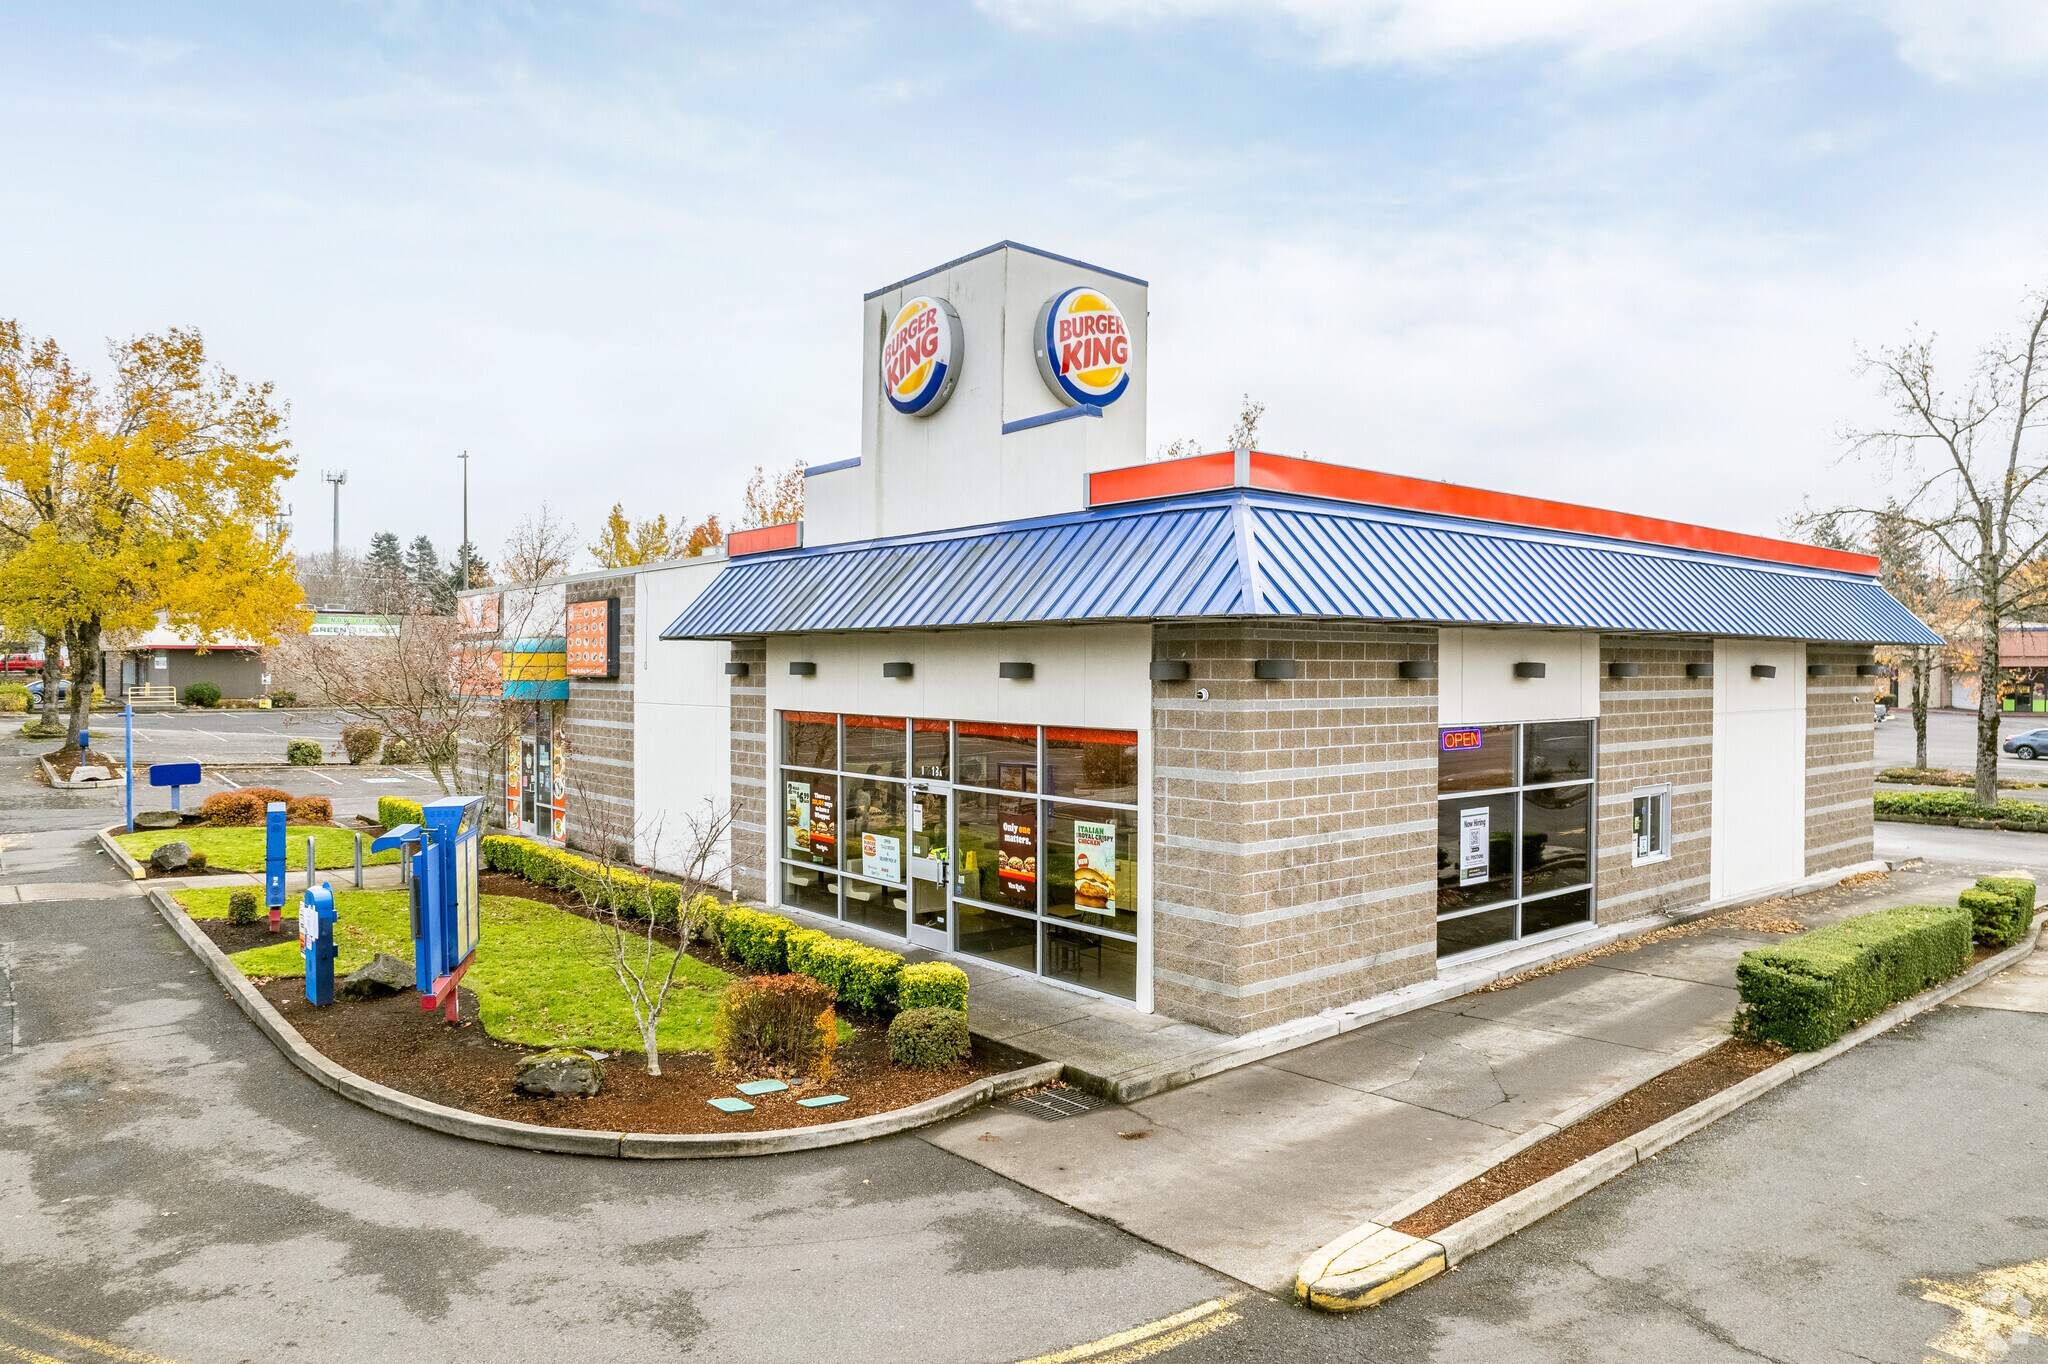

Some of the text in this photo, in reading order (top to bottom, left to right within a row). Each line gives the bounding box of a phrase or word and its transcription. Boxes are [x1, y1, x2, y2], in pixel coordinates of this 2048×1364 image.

[1060, 314, 1125, 342] BURGER
[885, 308, 937, 367] BURGER
[1061, 336, 1128, 375] KING
[887, 326, 938, 398] KING
[1444, 731, 1479, 748] OPEN
[788, 783, 793, 794] 2
[1002, 822, 1031, 834] Only one
[1463, 818, 1486, 828] Now Hiring
[1077, 825, 1104, 835] ITALIAN
[1004, 834, 1031, 845] matters.
[1078, 832, 1094, 840] ROYAL
[1077, 838, 1101, 846] CHICKEN
[864, 844, 876, 853] KING
